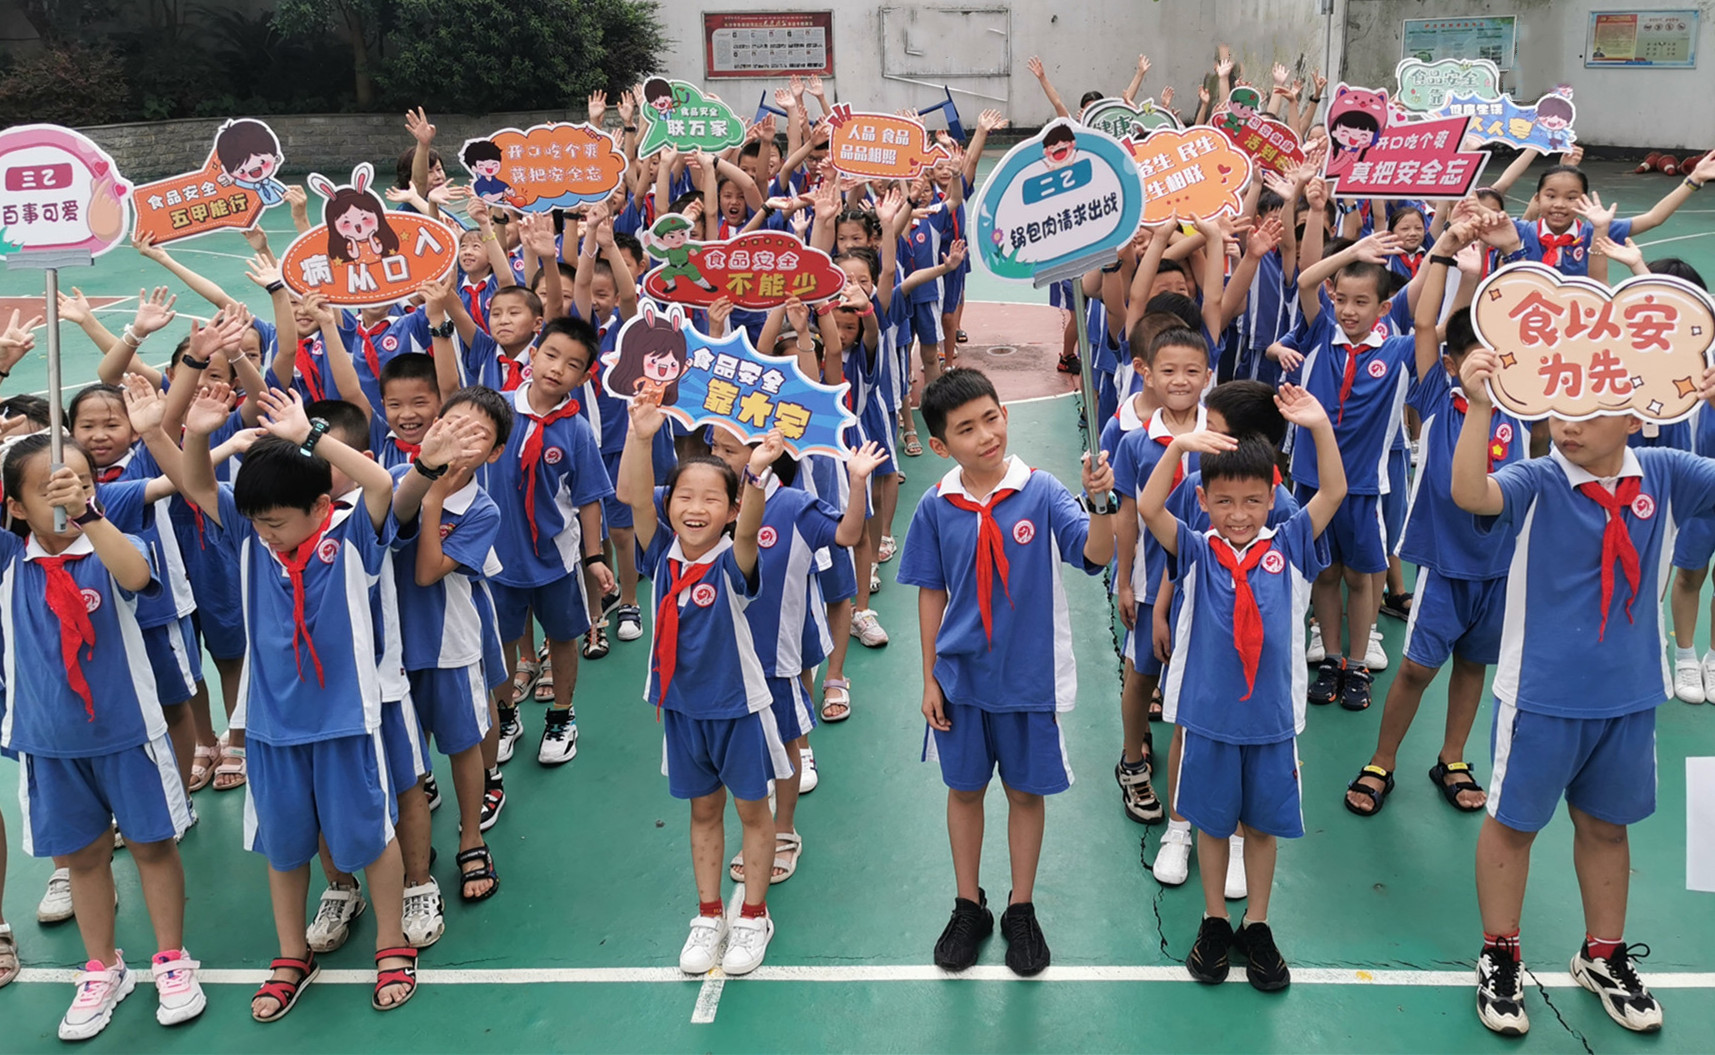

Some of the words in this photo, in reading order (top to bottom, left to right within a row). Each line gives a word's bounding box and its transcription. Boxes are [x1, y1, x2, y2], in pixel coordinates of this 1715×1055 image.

[1411, 68, 1479, 86] 食品安全
[680, 106, 719, 117] 食品安全
[666, 119, 728, 137] 联万家
[848, 124, 876, 142] 人品
[882, 127, 910, 146] 食品
[1375, 129, 1450, 151] 开口吃个爽
[507, 143, 600, 160] 开口吃个爽
[840, 144, 897, 165] 品品相照
[1177, 135, 1219, 162] 民生
[21, 168, 57, 189] 三乙
[509, 164, 603, 184] 莫把安全忘
[1040, 169, 1076, 197] 二乙
[1346, 158, 1469, 186] 莫把安全忘
[147, 181, 218, 211] 食品安全
[2, 200, 79, 226] 百事可爱
[169, 193, 249, 230] 五甲能行
[1010, 192, 1119, 249] 锅包肉请求出战
[299, 226, 445, 294] 病从口入
[703, 250, 800, 271] 食品安全
[726, 272, 817, 297] 不能少
[1508, 290, 1680, 353] 食以安
[692, 346, 786, 394] 食品安全
[1537, 349, 1635, 398] 为先
[703, 378, 812, 440] 靠大家
